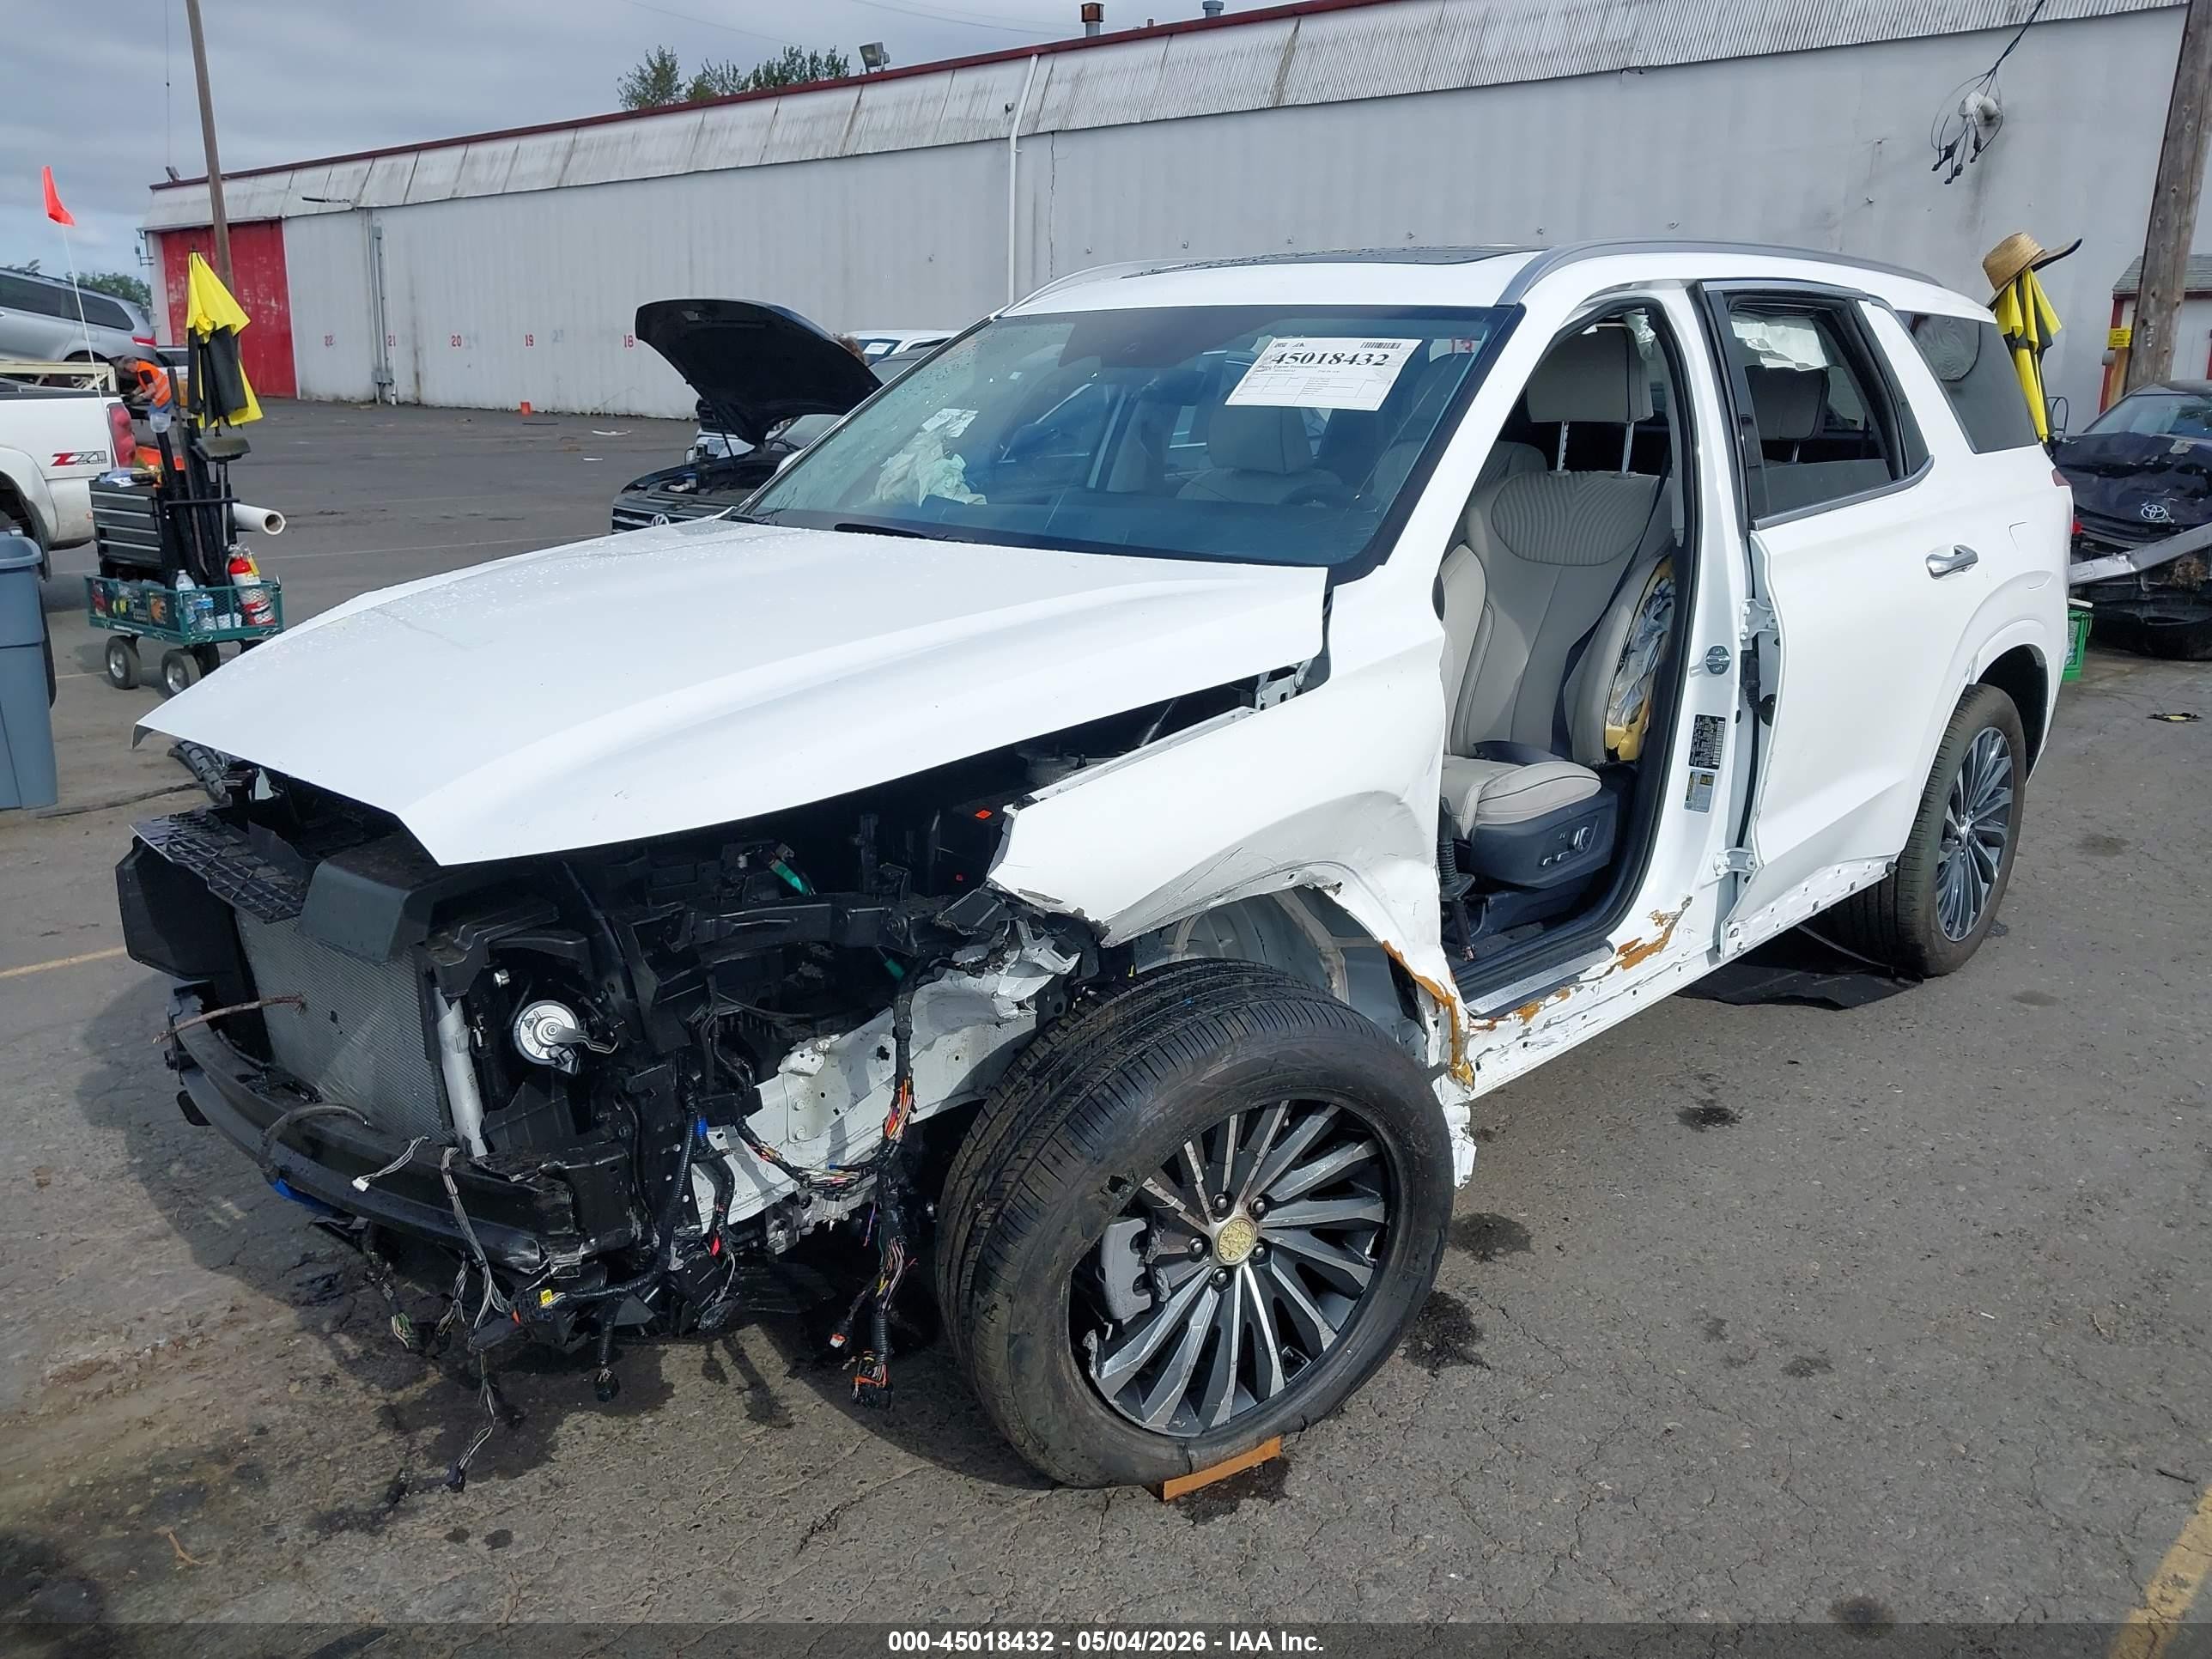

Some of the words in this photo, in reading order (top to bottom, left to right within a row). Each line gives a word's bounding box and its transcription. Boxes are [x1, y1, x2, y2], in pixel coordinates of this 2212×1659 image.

[387, 334, 397, 347] 21
[451, 334, 462, 348] 20
[525, 333, 534, 347] 19
[623, 334, 634, 348] 18
[1272, 352, 1389, 366] 45018432
[1476, 979, 1537, 1009] PALISADE
